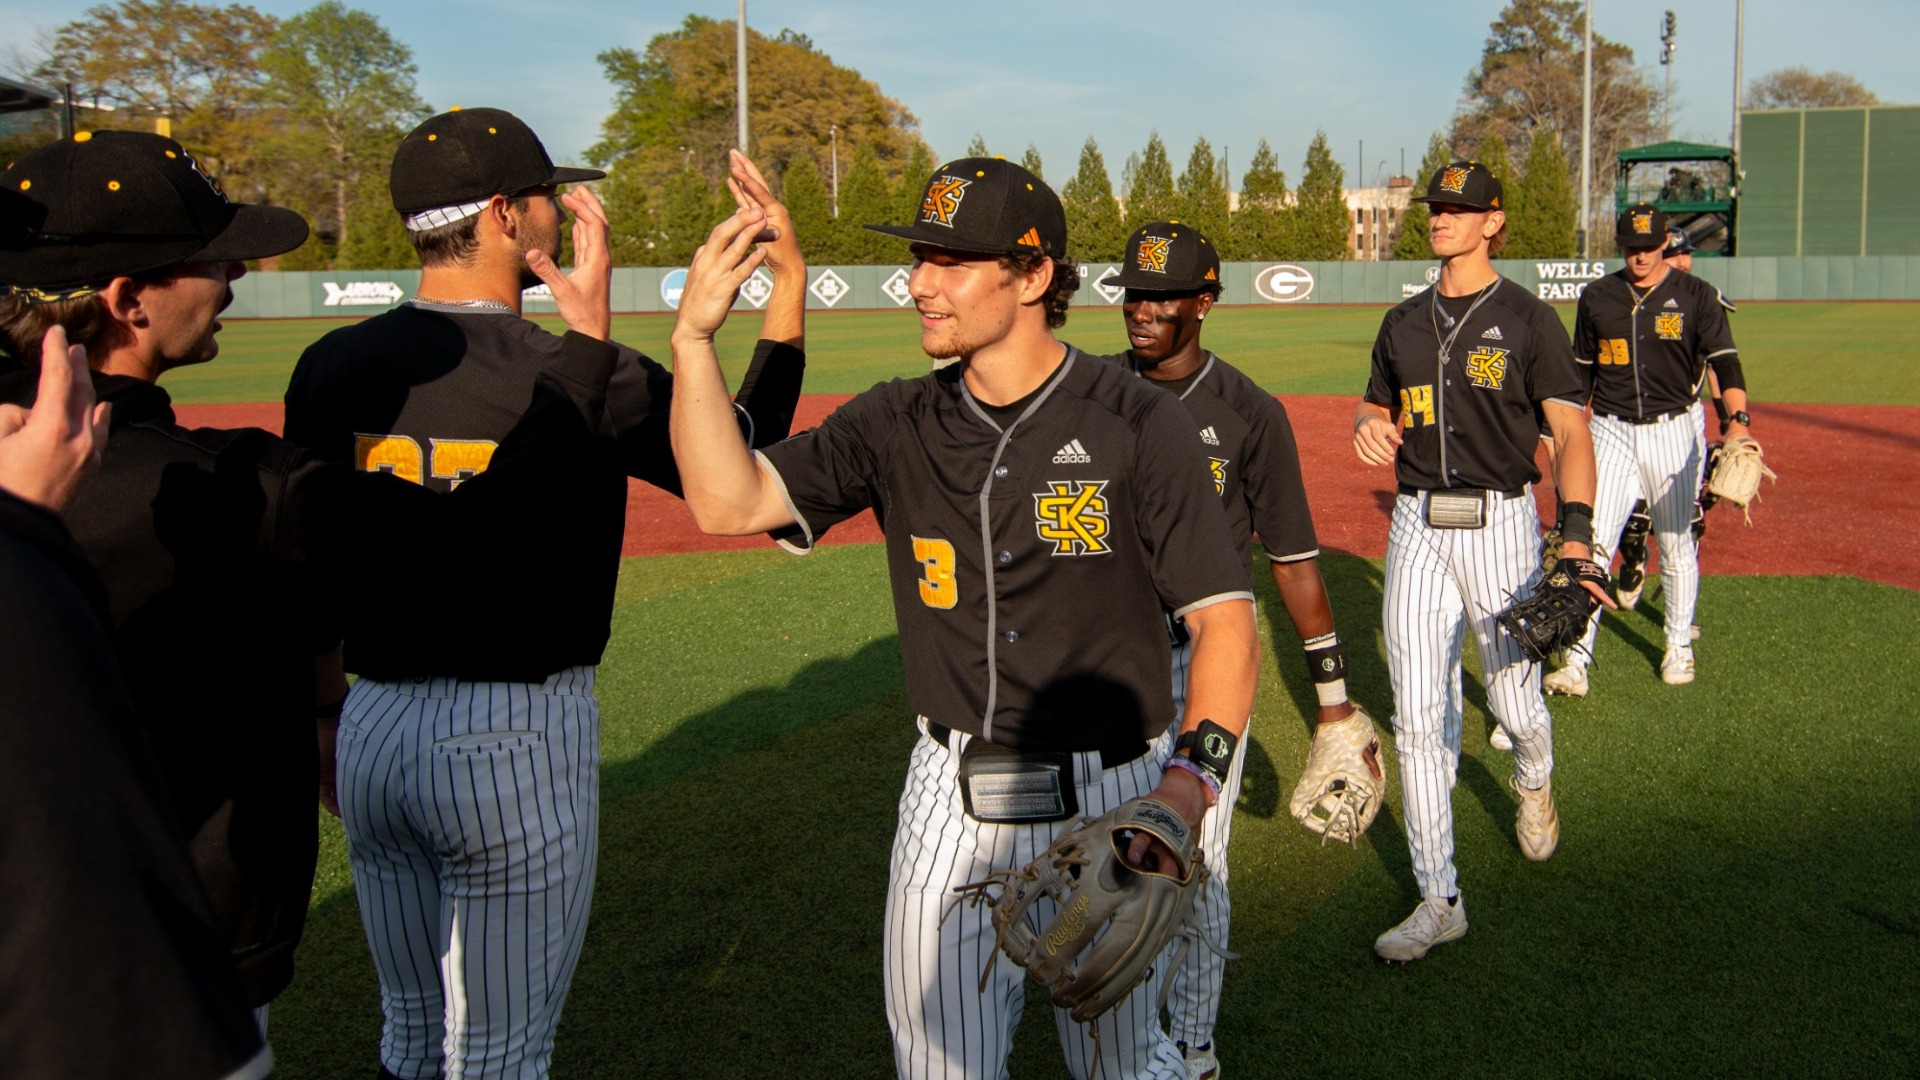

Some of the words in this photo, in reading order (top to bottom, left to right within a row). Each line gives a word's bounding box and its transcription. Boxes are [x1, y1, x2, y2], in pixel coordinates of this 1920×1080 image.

[1536, 262, 1605, 279] WELLS
[1538, 283, 1588, 300] FAR
[1052, 453, 1092, 464] adidas
[911, 534, 958, 610] 3
[1045, 894, 1090, 956] Rawlings
